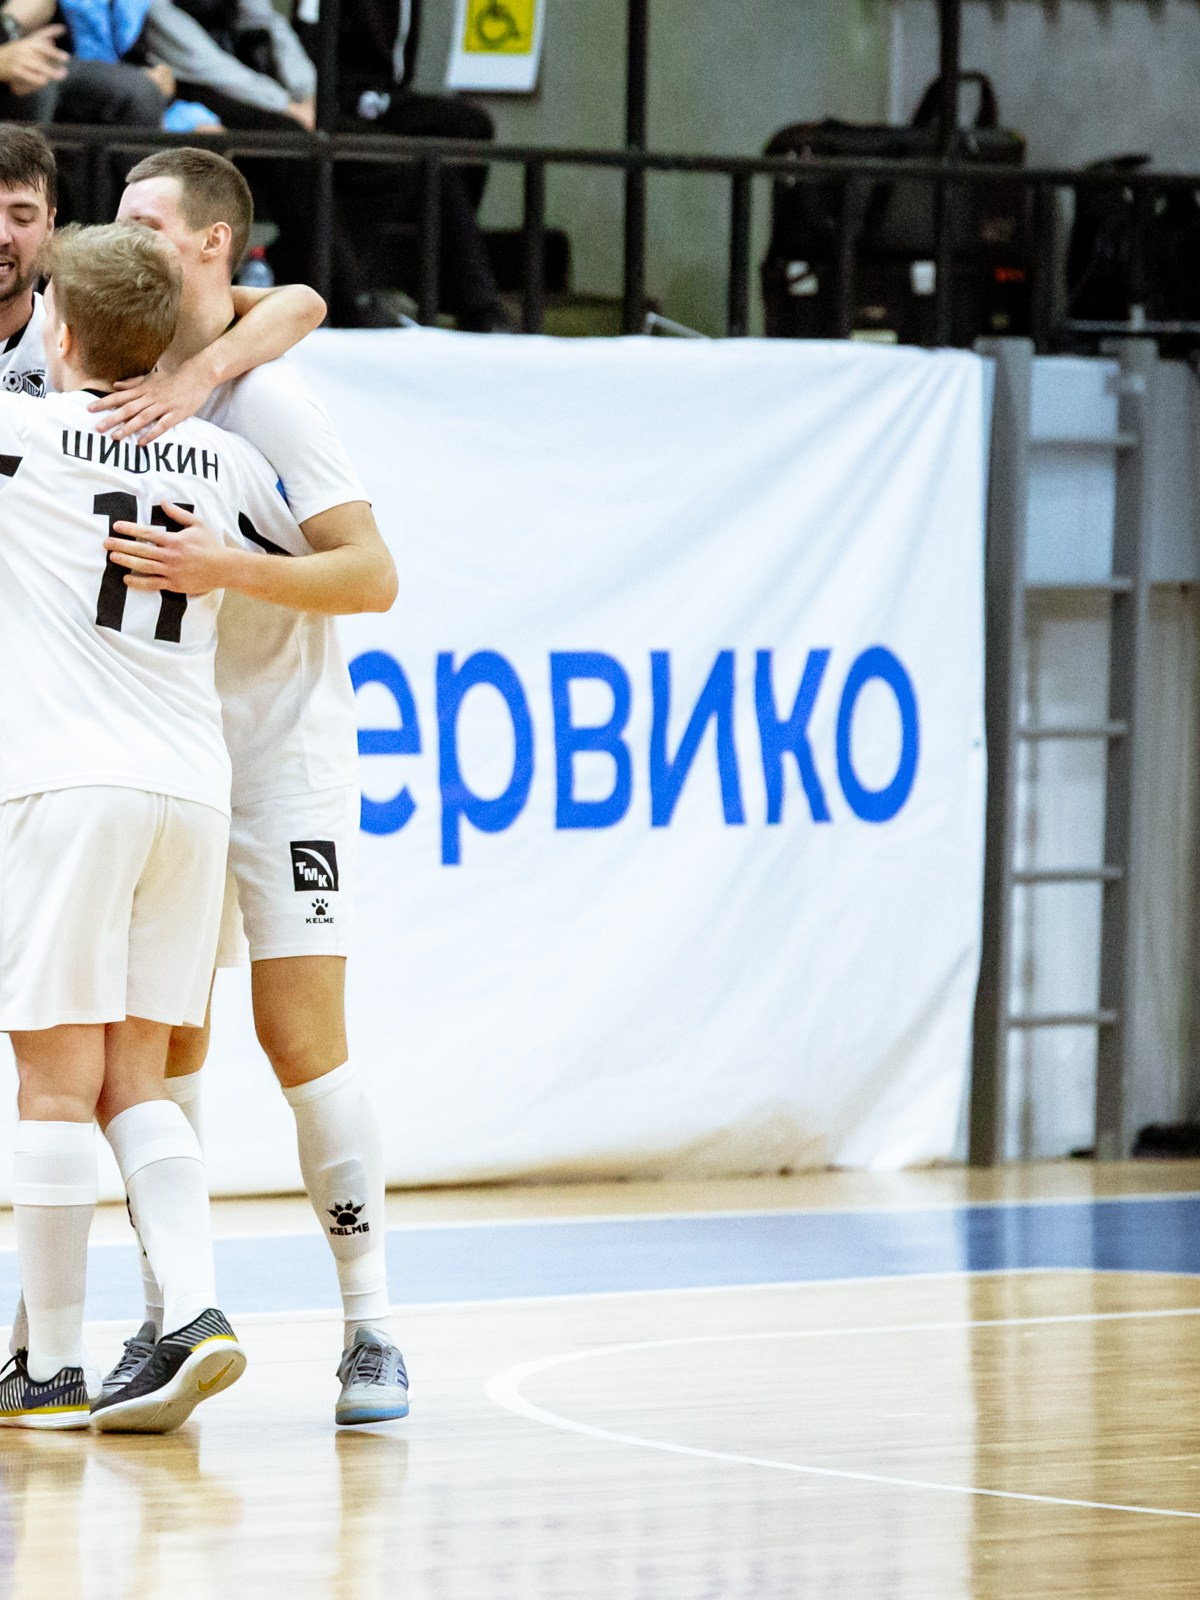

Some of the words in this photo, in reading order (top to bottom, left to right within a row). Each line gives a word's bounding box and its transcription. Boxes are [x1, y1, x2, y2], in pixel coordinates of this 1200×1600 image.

[62, 429, 219, 483] ШИШКИН
[93, 491, 195, 644] 11
[329, 1221, 370, 1236] KELME
